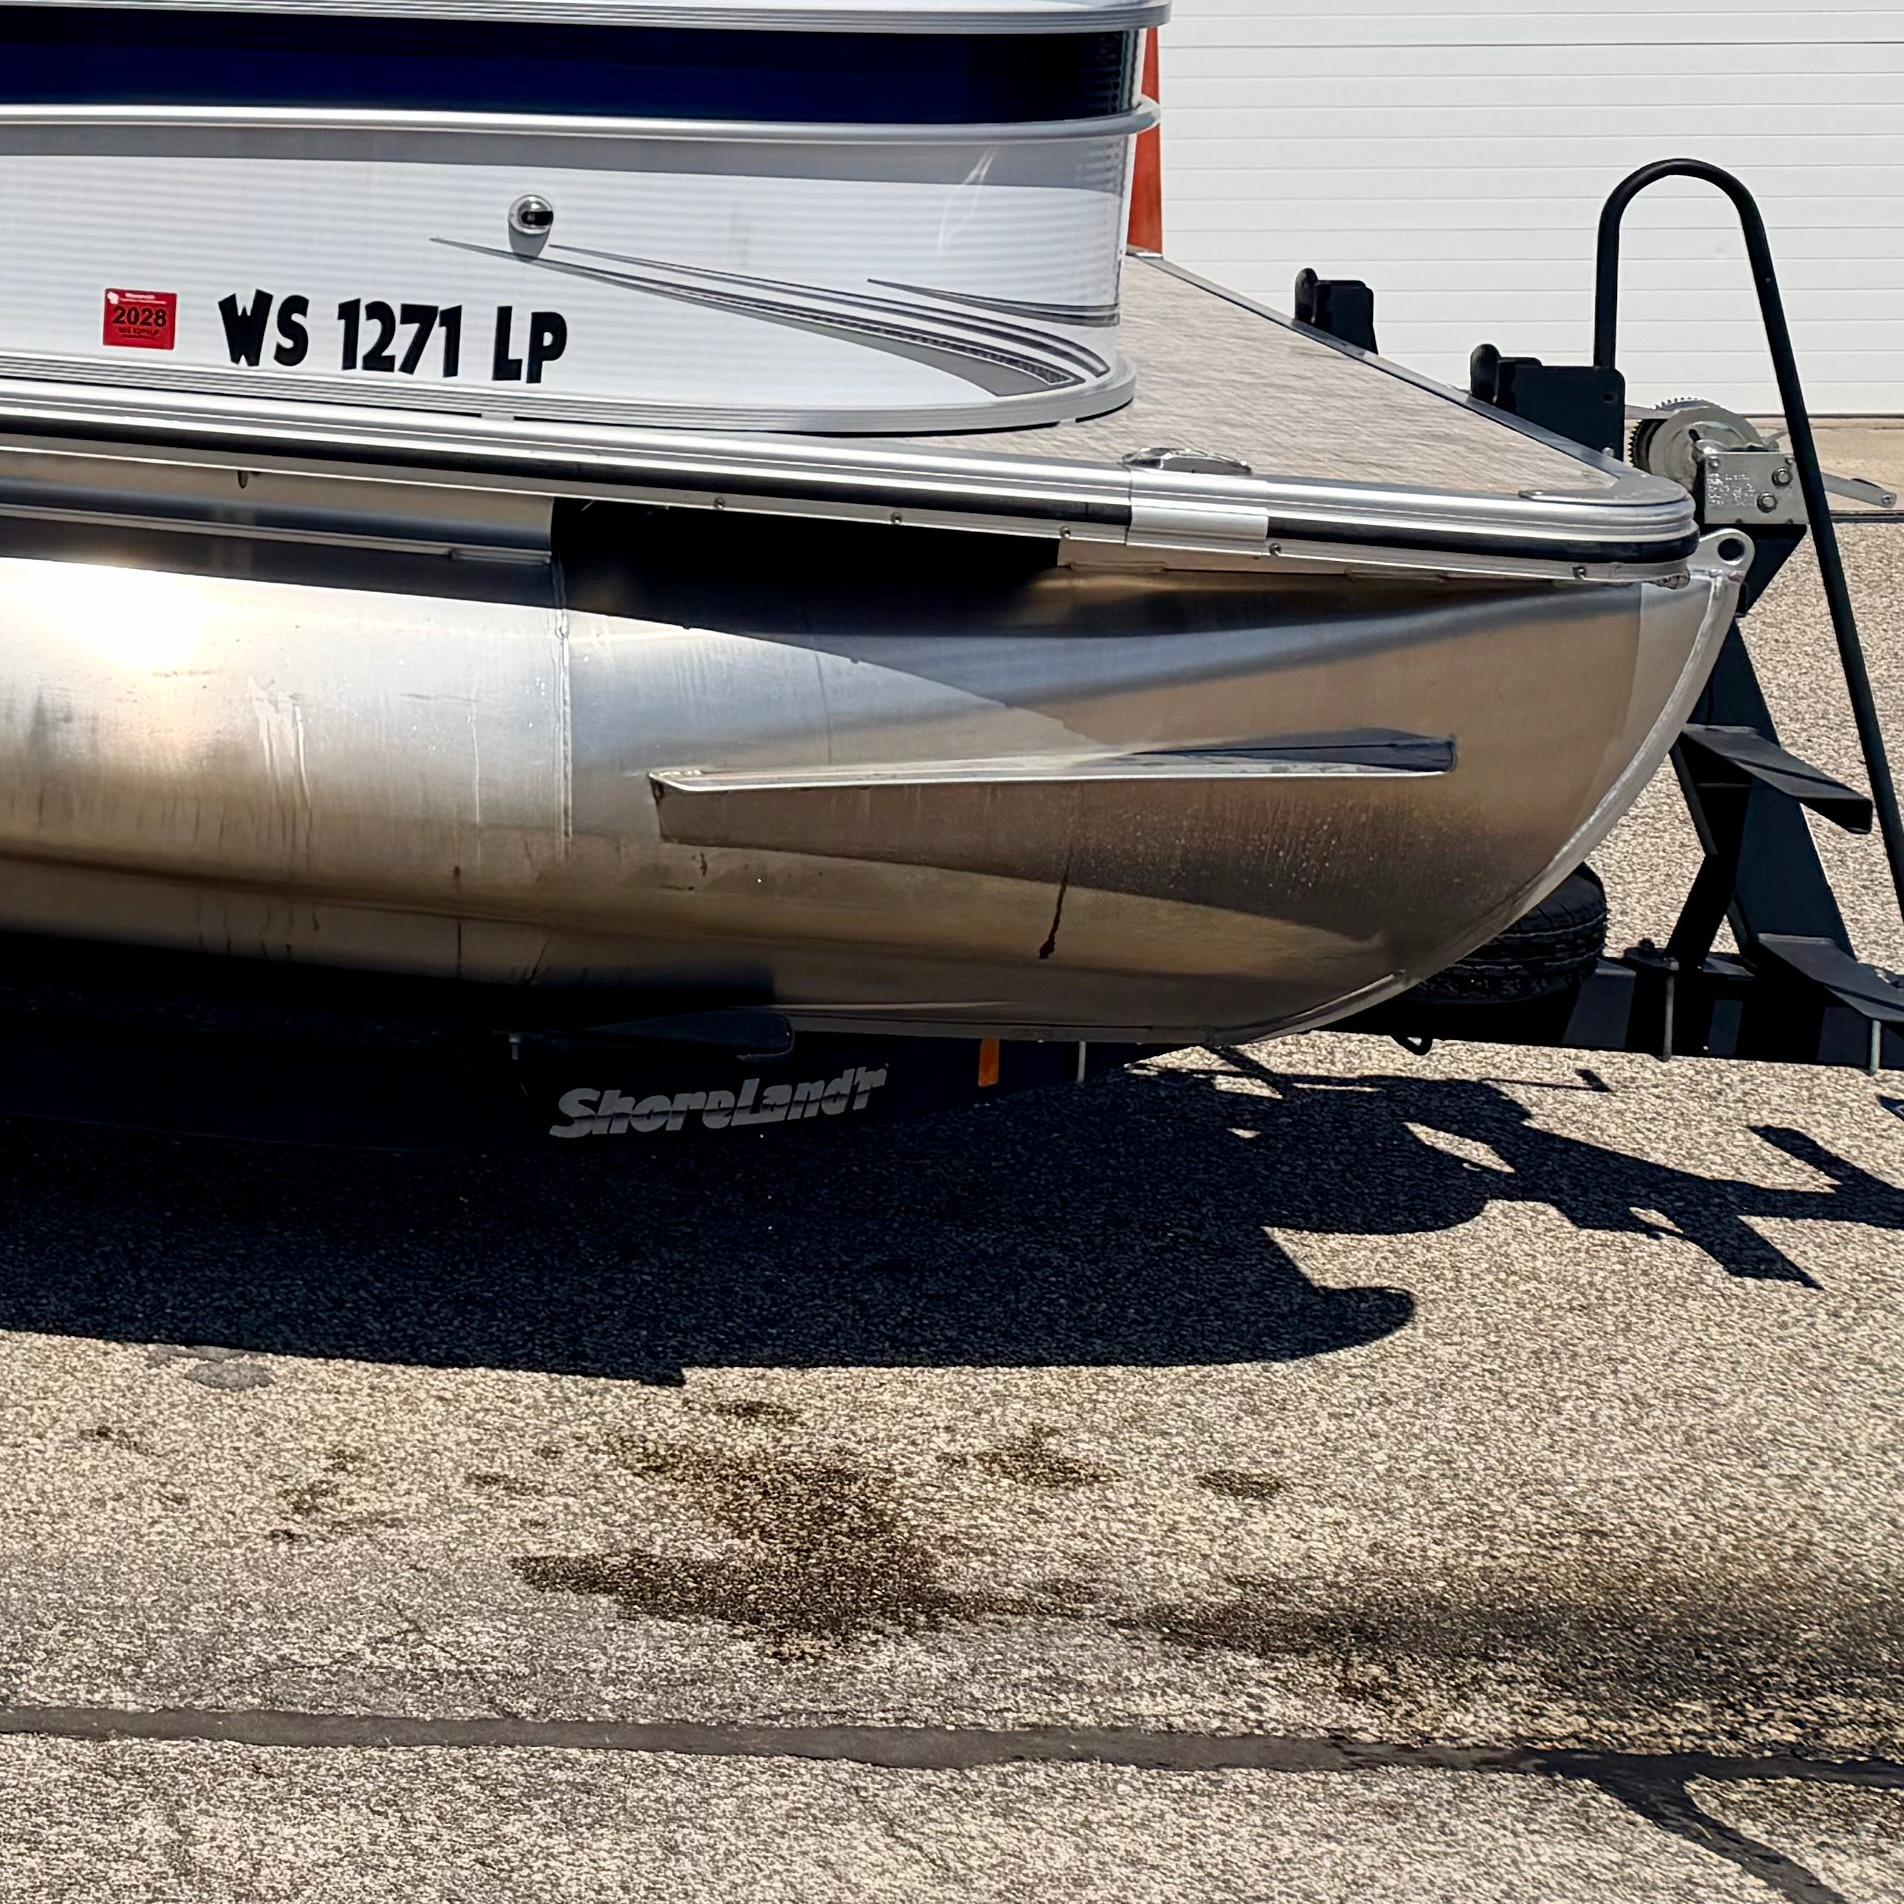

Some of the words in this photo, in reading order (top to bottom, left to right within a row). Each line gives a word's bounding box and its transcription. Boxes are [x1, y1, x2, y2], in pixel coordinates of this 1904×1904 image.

[112, 305, 167, 328] 2028
[217, 288, 310, 367] WS
[337, 297, 463, 378] 1271
[491, 305, 568, 384] LP
[549, 1063, 888, 1139] ShoreLand'r
